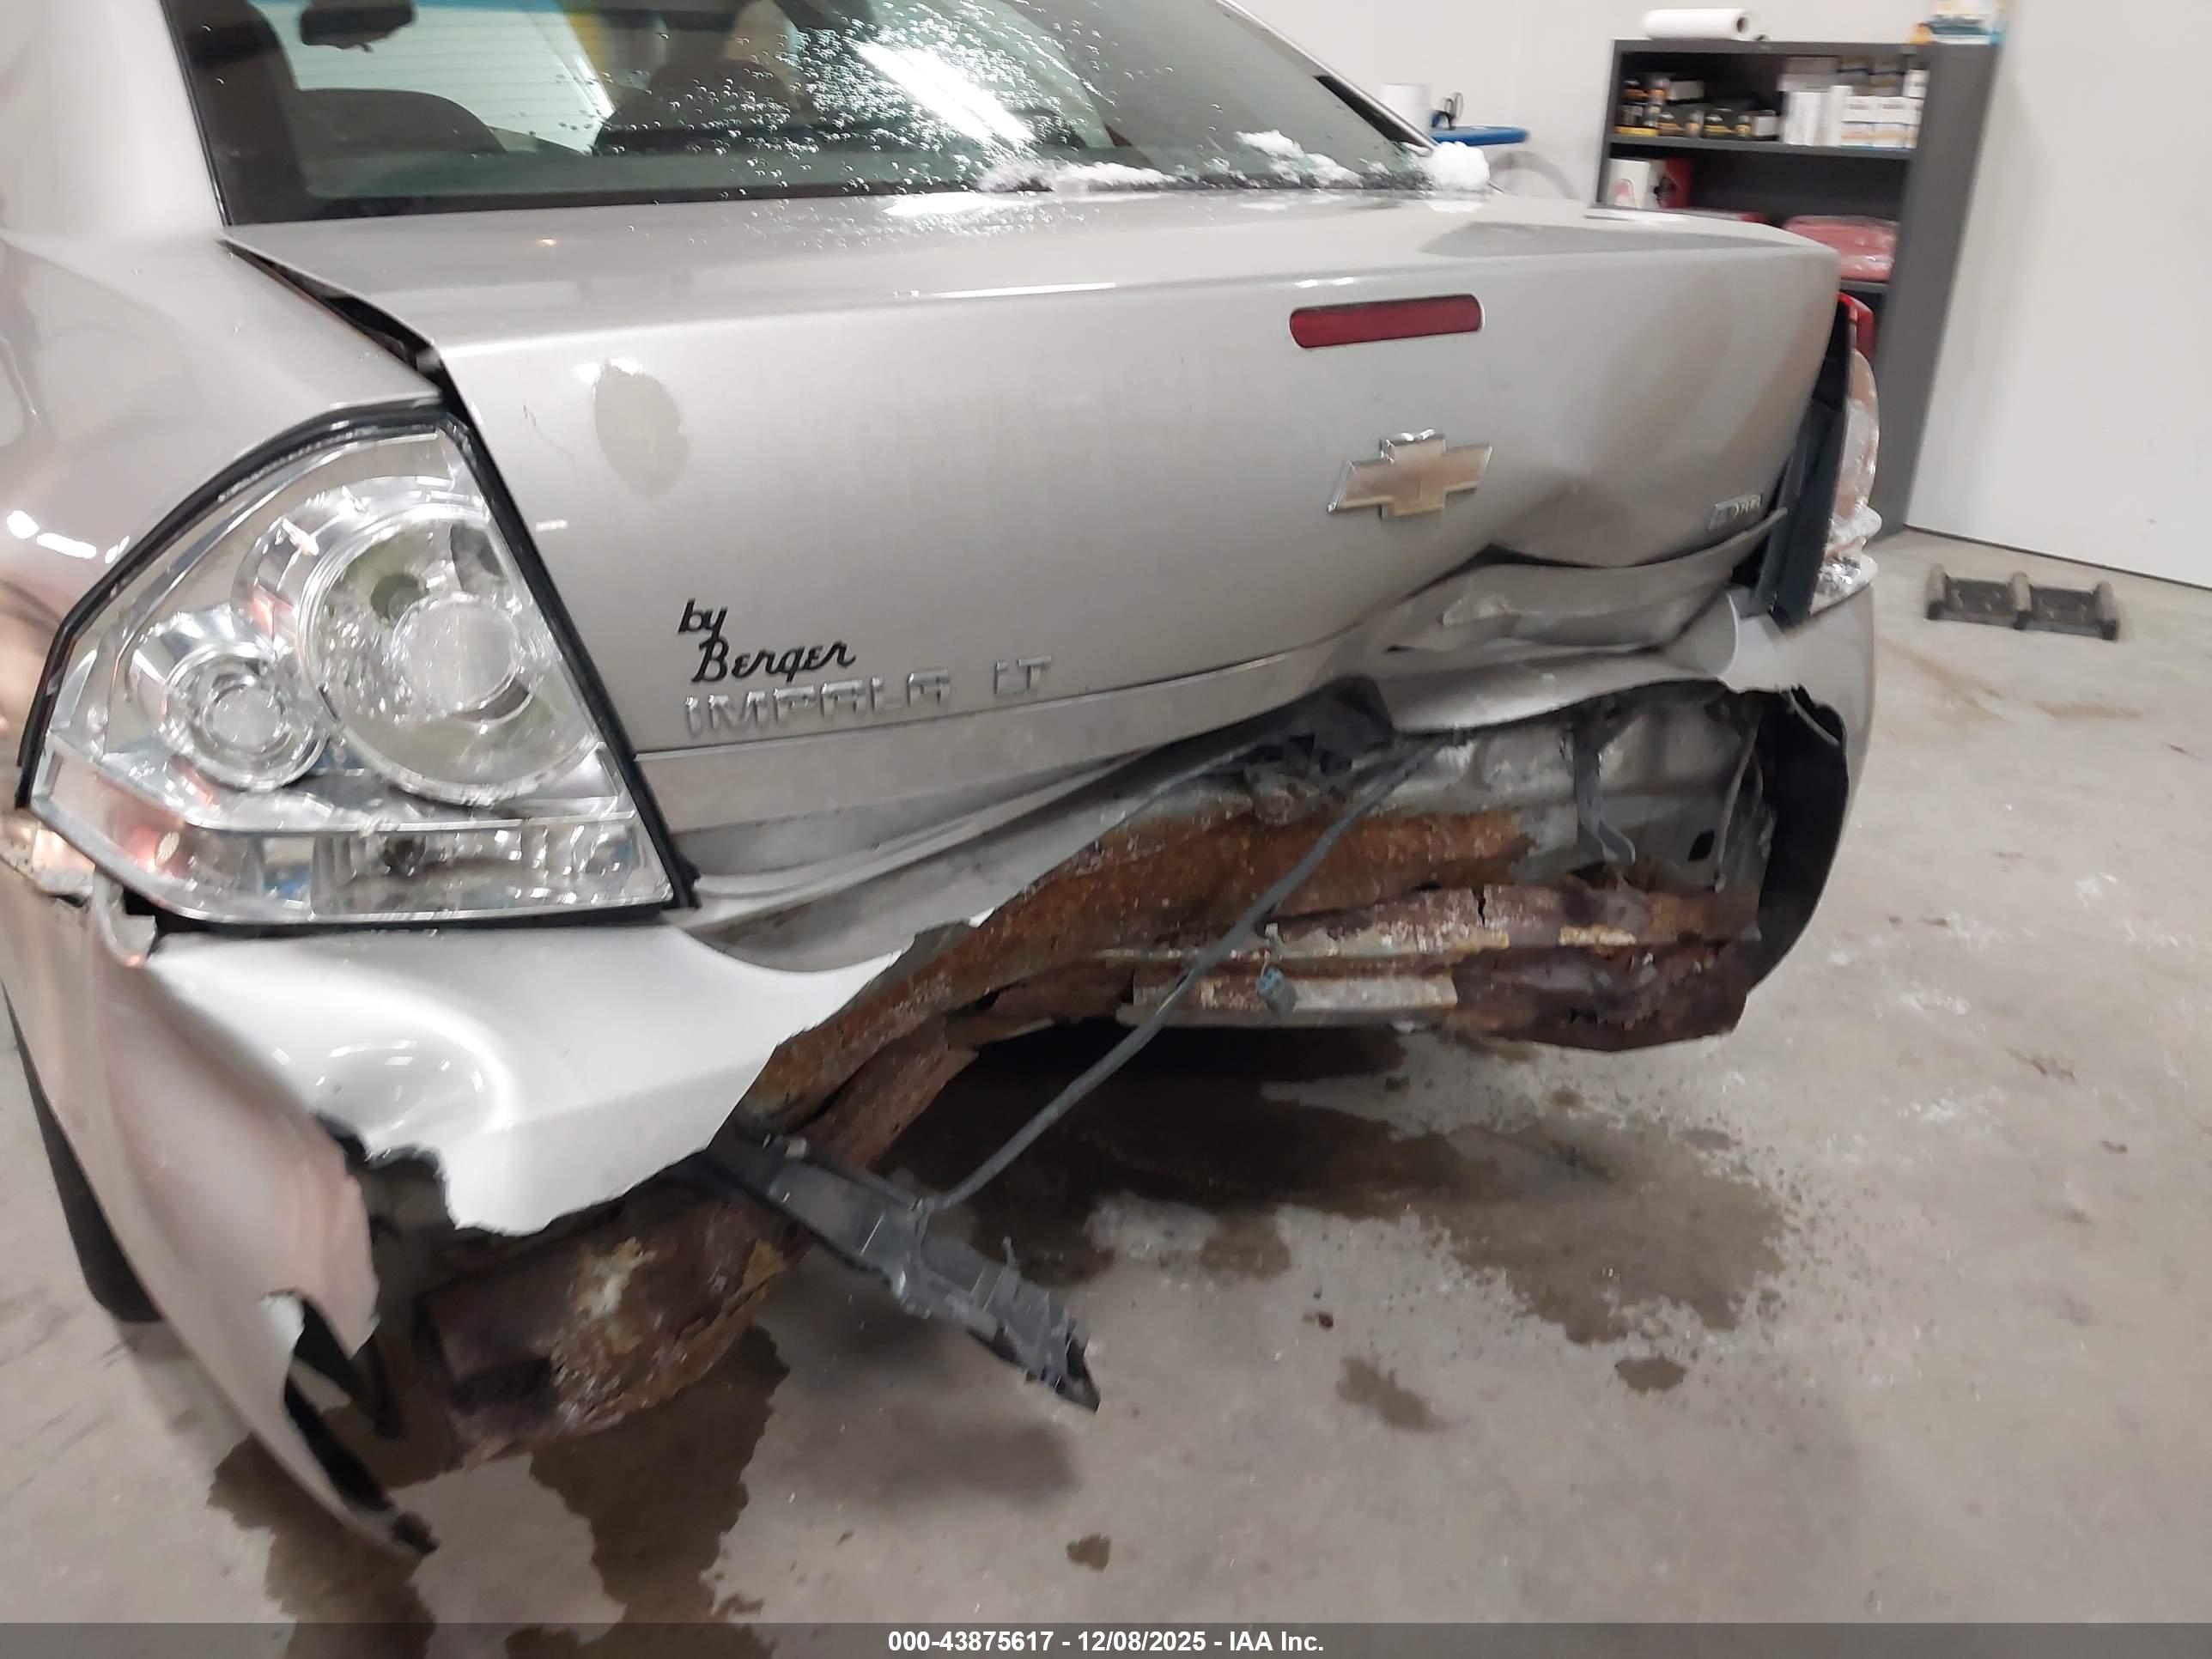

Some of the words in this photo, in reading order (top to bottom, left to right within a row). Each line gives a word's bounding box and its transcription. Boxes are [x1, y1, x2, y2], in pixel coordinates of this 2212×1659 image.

[678, 598, 728, 639] by
[690, 635, 857, 684] Berger
[684, 666, 951, 737] IMPALA
[994, 654, 1053, 696] LT
